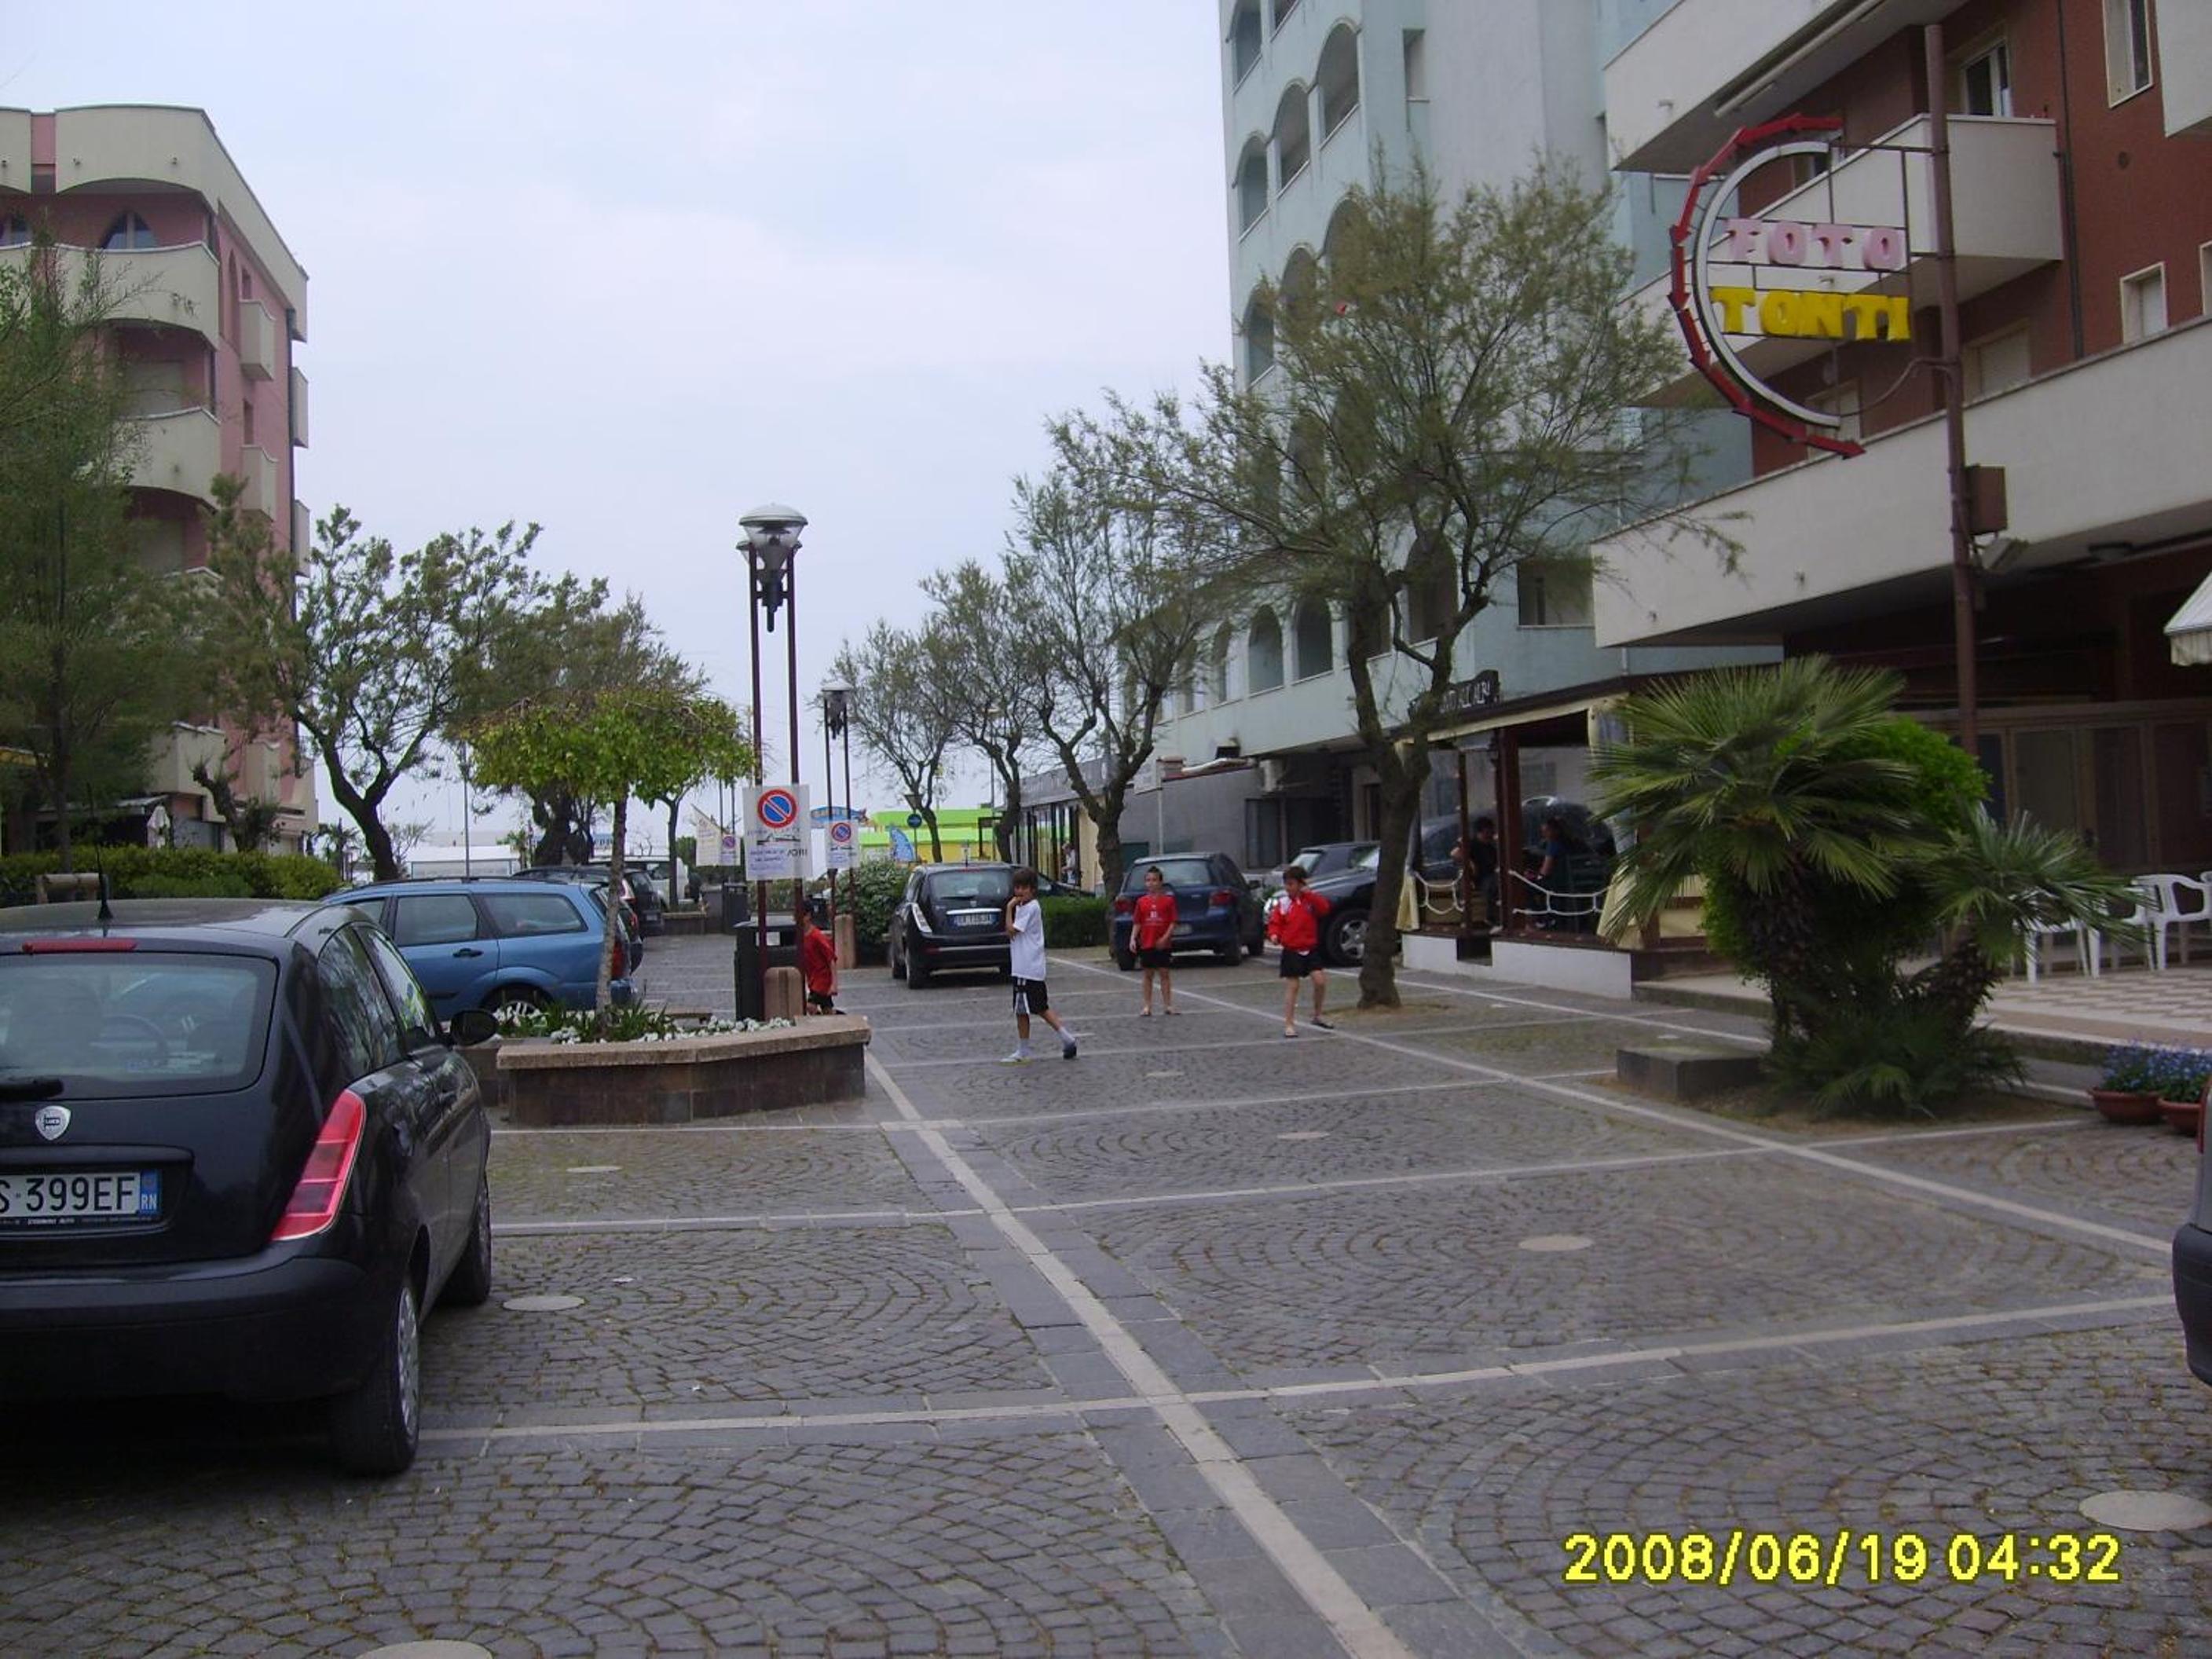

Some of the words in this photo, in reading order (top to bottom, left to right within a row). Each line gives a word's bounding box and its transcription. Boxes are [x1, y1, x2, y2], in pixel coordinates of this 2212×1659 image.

[1726, 218, 1901, 270] FOTO
[1710, 287, 1911, 341] TONTI
[26, 1176, 135, 1212] 399EF
[141, 1194, 157, 1210] RN
